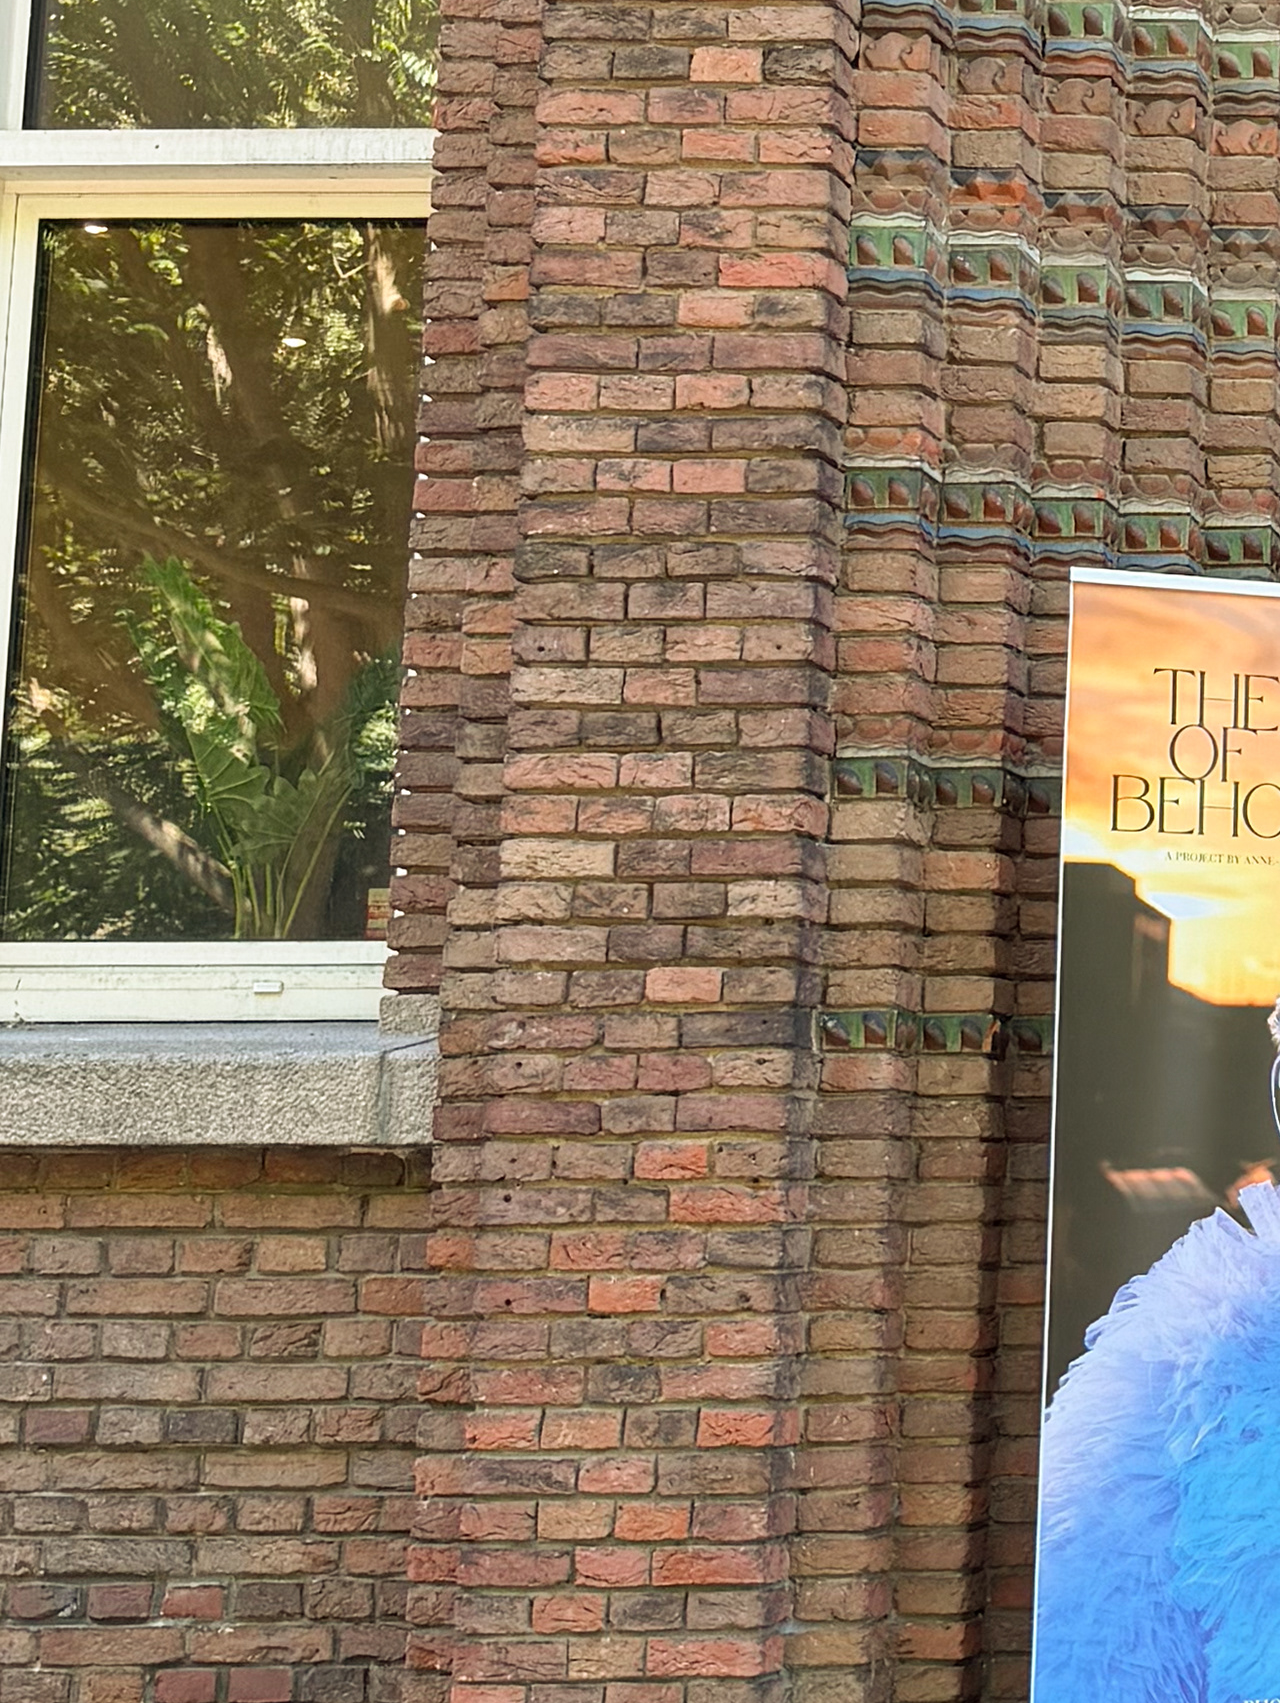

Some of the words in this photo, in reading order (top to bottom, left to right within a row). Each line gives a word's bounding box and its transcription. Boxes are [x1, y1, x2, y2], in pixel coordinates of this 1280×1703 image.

[1153, 668, 1280, 731] THE
[1169, 724, 1258, 782] OF
[1165, 851, 1172, 861] A
[1175, 851, 1224, 864] PROJECT
[1226, 854, 1240, 865] BY
